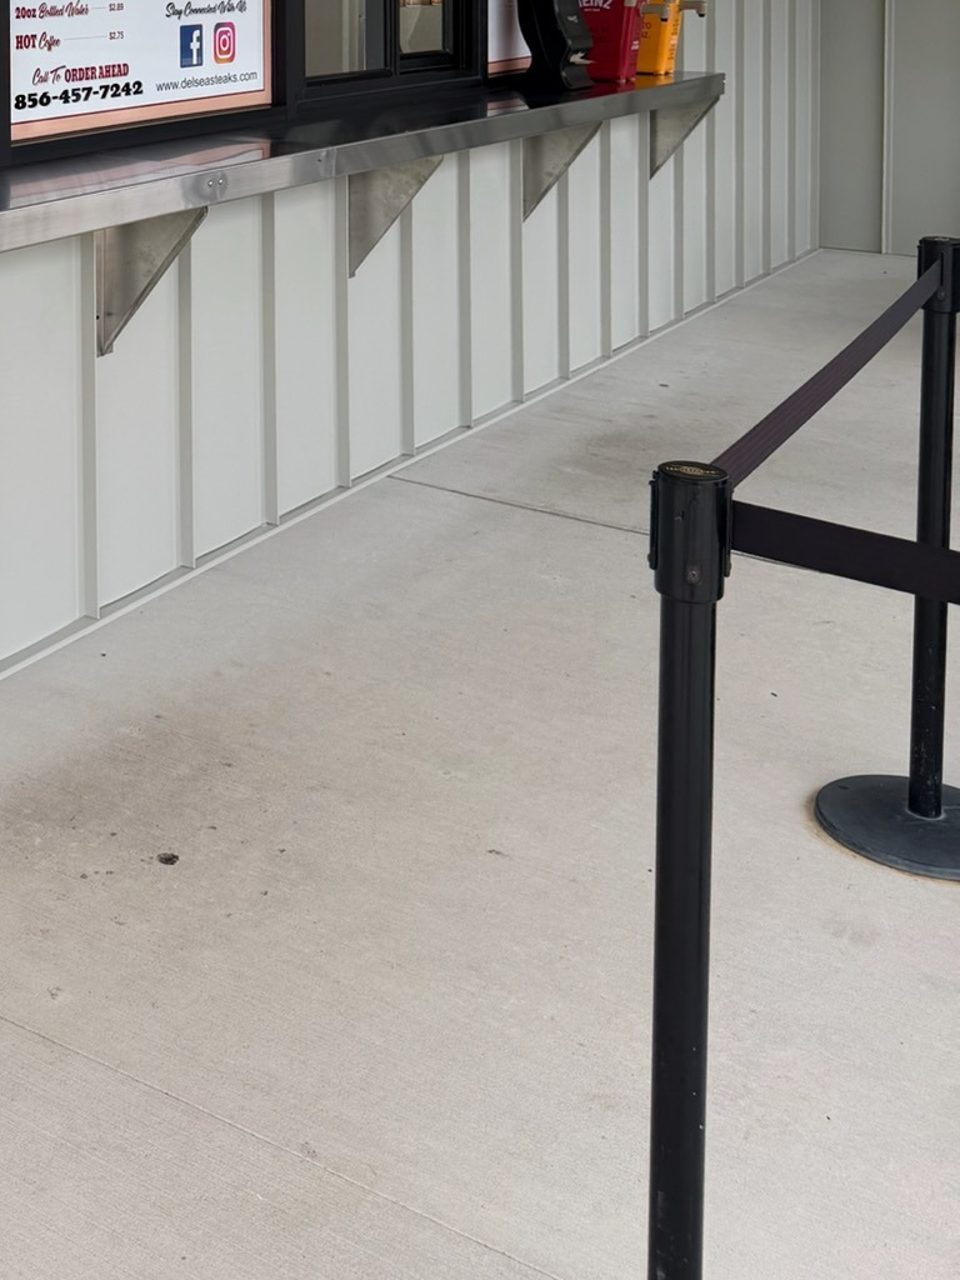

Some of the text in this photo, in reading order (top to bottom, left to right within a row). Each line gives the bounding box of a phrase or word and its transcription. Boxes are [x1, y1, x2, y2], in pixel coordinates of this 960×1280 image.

[15, 6, 37, 19] 20oz
[15, 31, 124, 51] HOT Coffee $2.75
[32, 63, 129, 85] Call To ORDER AHEAD
[155, 70, 258, 92] www.delseasteaks.com
[14, 80, 143, 110] 856-457-7242
